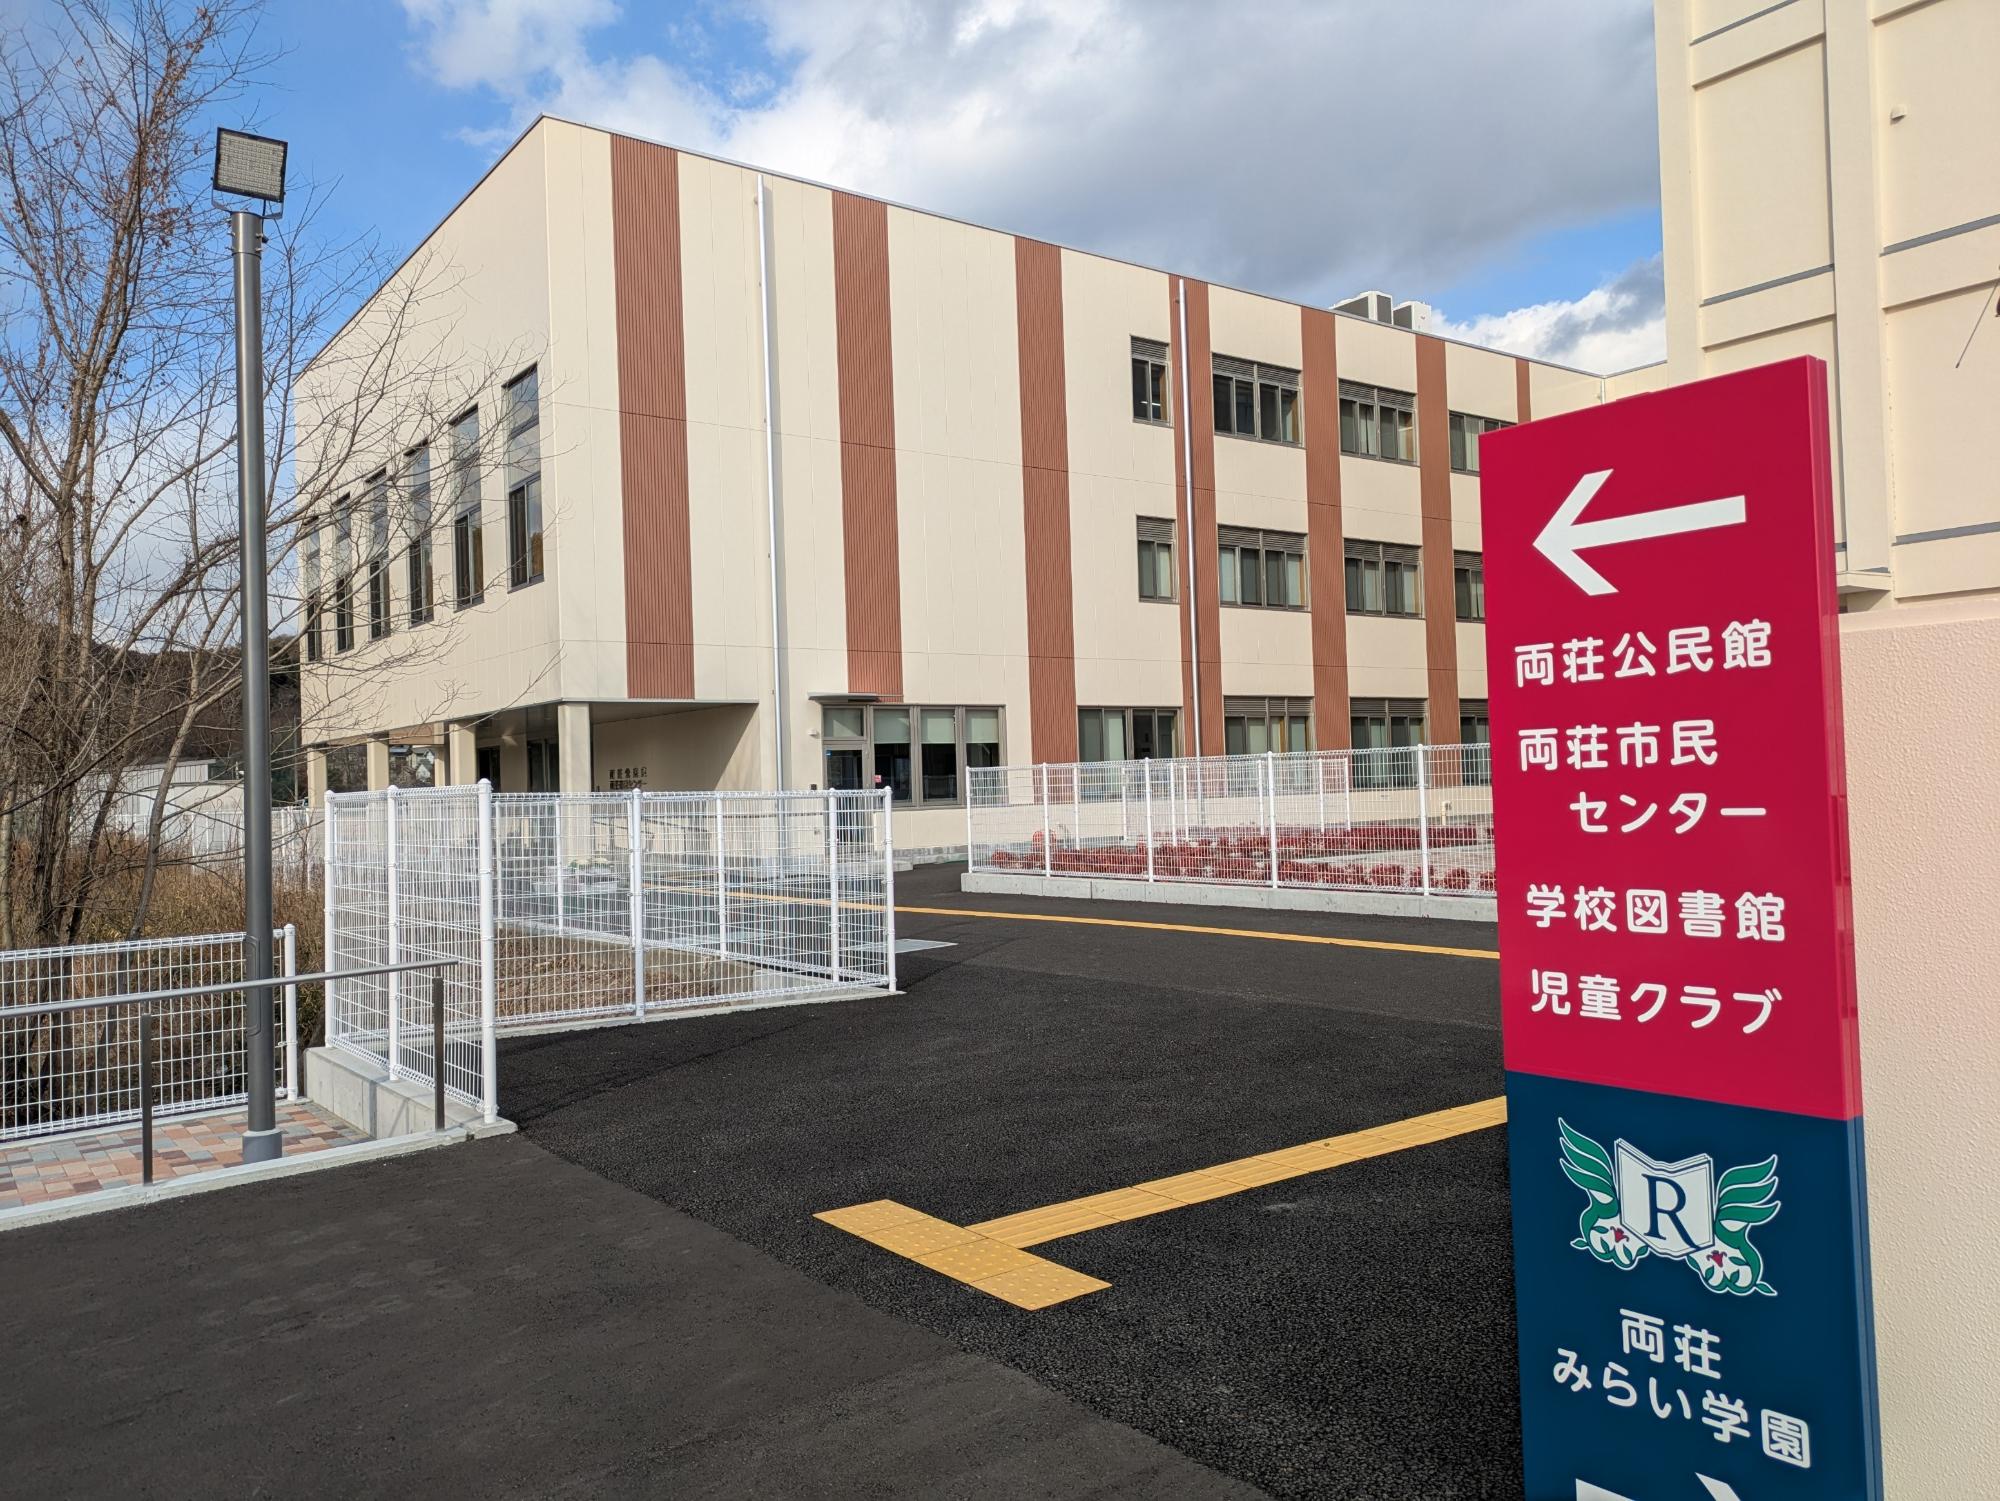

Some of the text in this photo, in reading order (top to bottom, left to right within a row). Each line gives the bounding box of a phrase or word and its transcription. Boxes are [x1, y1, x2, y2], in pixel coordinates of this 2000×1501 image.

[1513, 618, 1773, 688] 両荘公民館
[1517, 718, 1719, 773] 両荘市民
[1568, 791, 1768, 834] センター
[1525, 883, 1787, 943] 学校図書館
[1530, 967, 1783, 1035] 児童クラブ
[1642, 1172, 1702, 1250] R
[1618, 1307, 1723, 1380] 両荘
[1552, 1347, 1812, 1470] みらい学園
